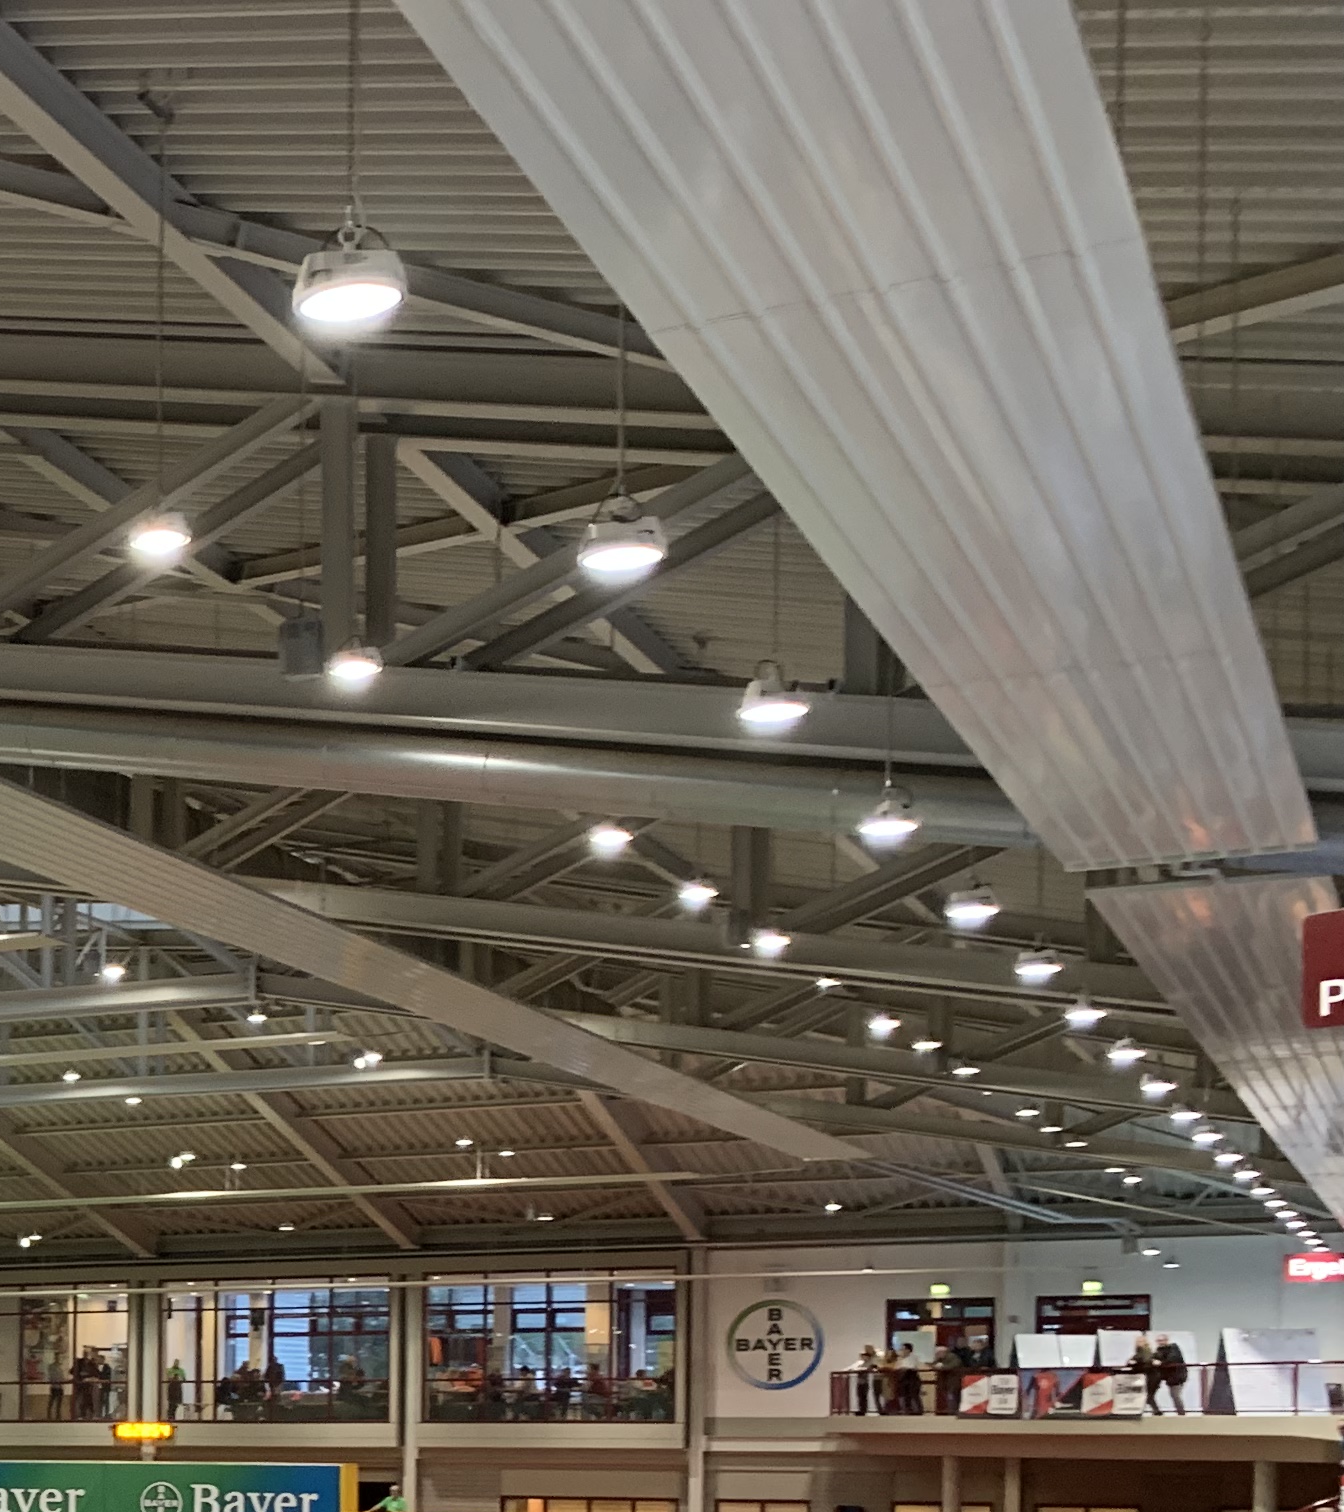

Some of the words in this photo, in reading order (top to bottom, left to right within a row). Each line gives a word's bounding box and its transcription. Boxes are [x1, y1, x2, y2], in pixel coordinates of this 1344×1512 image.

[735, 1337, 815, 1352] BAYER
[766, 1307, 784, 1381] BAYER
[143, 1498, 179, 1508] BAYER
